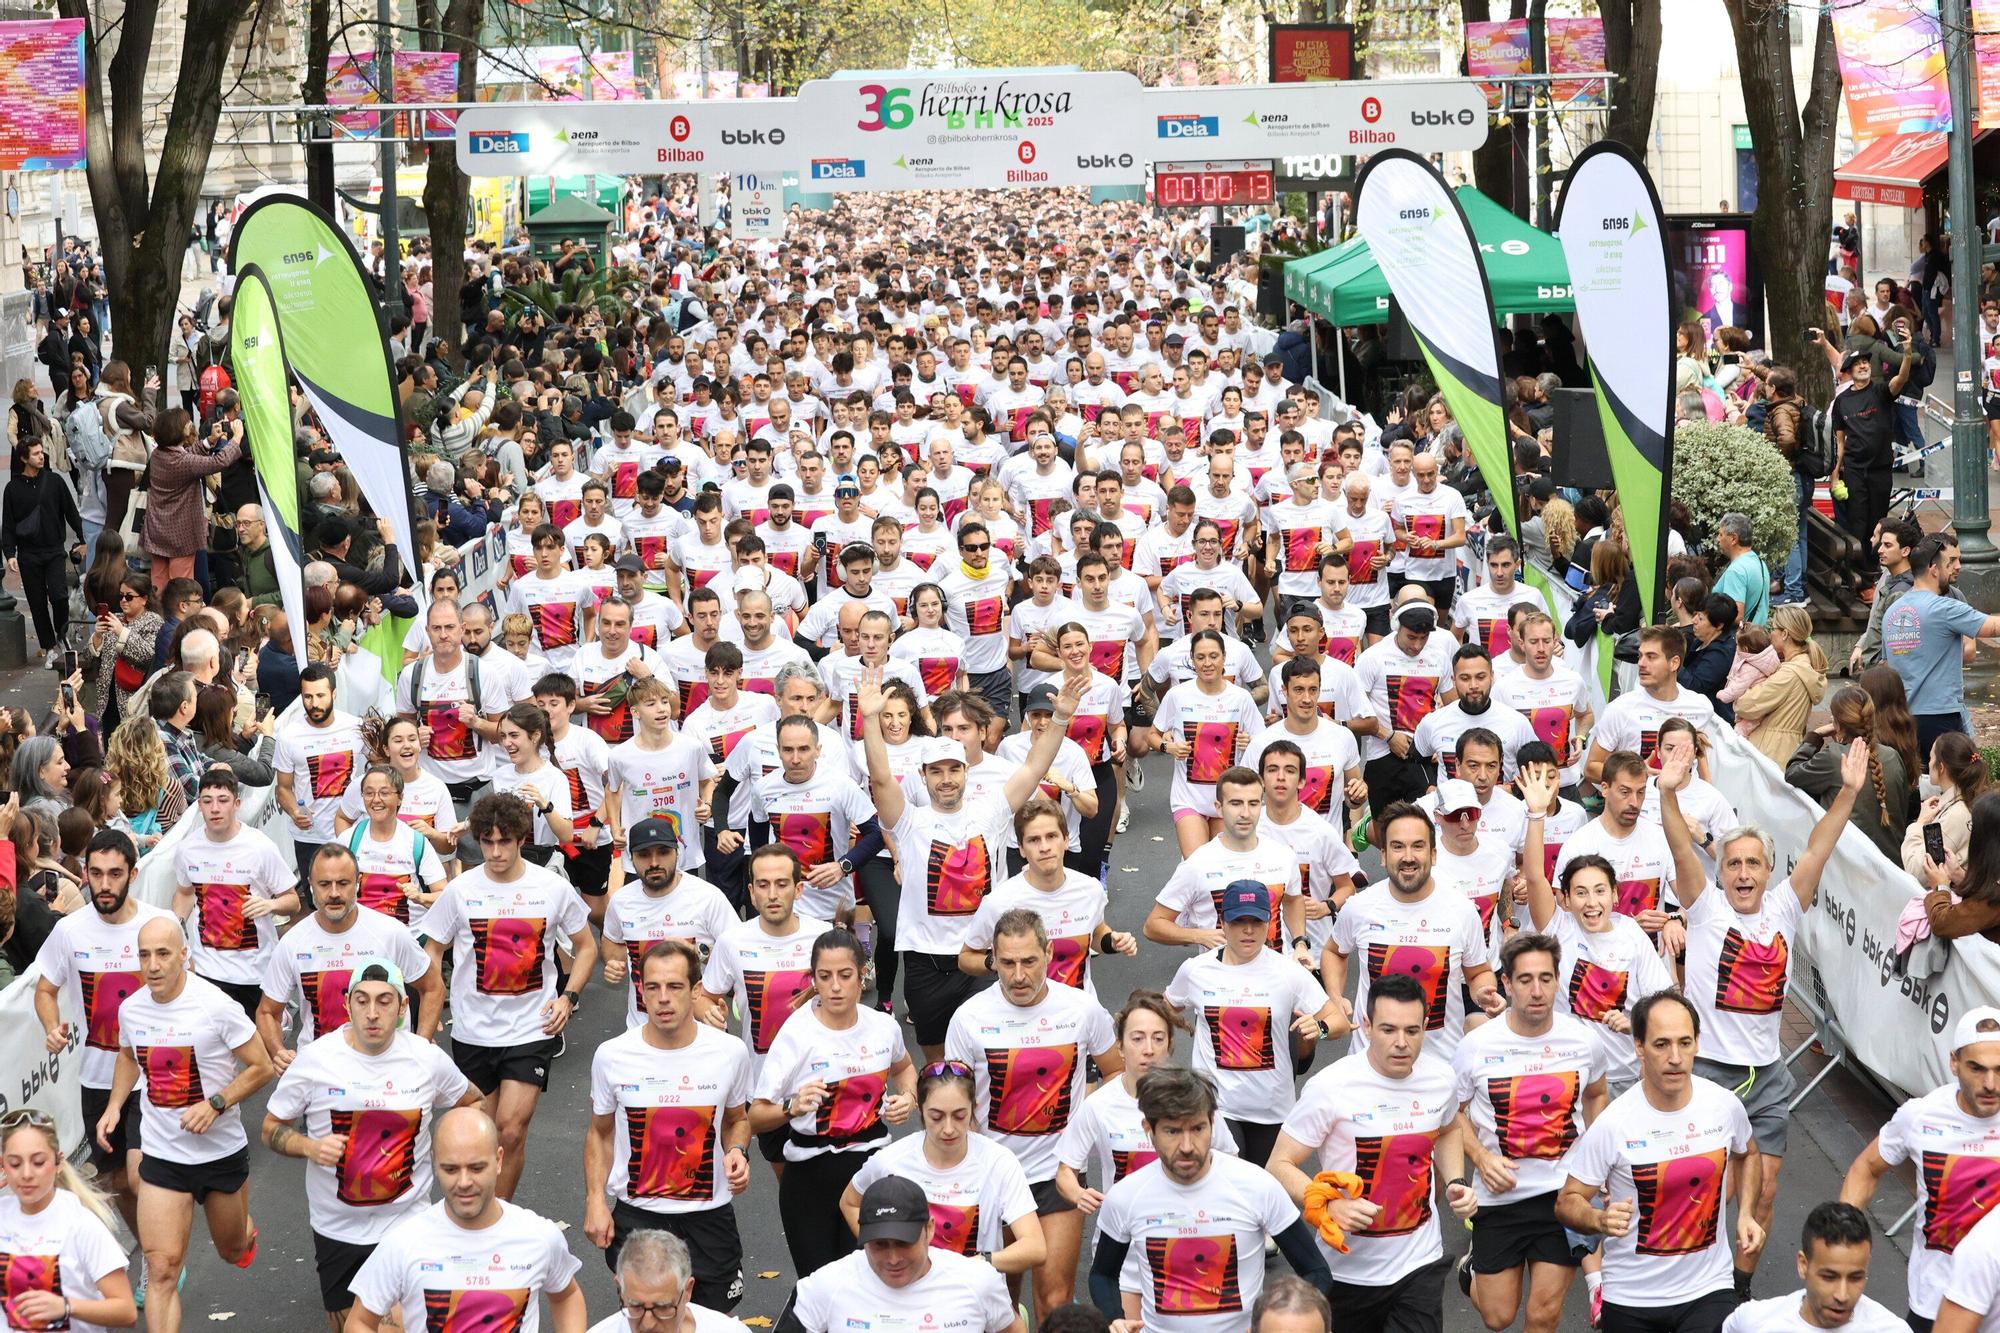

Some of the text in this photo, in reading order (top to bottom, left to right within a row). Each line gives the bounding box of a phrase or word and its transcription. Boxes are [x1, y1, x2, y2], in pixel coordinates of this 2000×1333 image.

[1469, 37, 1492, 47] Fair
[1470, 46, 1529, 60] Saturday
[934, 82, 977, 95] Bilboko
[857, 84, 914, 132] 36
[1027, 116, 1054, 127] 2025
[1261, 113, 1288, 123] aena
[1411, 109, 1454, 126] bbk
[571, 130, 598, 139] aena
[1167, 120, 1208, 137] Deia
[721, 128, 766, 145] bbk
[1349, 130, 1396, 144] Bilbao
[478, 136, 519, 153] Deia
[657, 148, 704, 162] Bilbao
[909, 157, 933, 166] aena
[1077, 155, 1116, 169] bbk
[819, 163, 857, 178] Deia
[1007, 169, 1048, 182] Bilbao
[736, 174, 777, 191] 10 km.
[742, 207, 763, 215] bbk
[1684, 245, 1726, 263] 11.11
[652, 795, 675, 807] 3708
[1825, 889, 1845, 930] bbk
[1399, 935, 1418, 943] 2122
[1862, 928, 1884, 970] bbk
[104, 961, 122, 970] 5741
[326, 959, 344, 968] 2625
[1020, 1036, 1041, 1045] 1255
[22, 1061, 49, 1105] bbk
[658, 1095, 681, 1103] 0222
[1393, 1121, 1414, 1131] 0044
[465, 1276, 491, 1286] 5785
